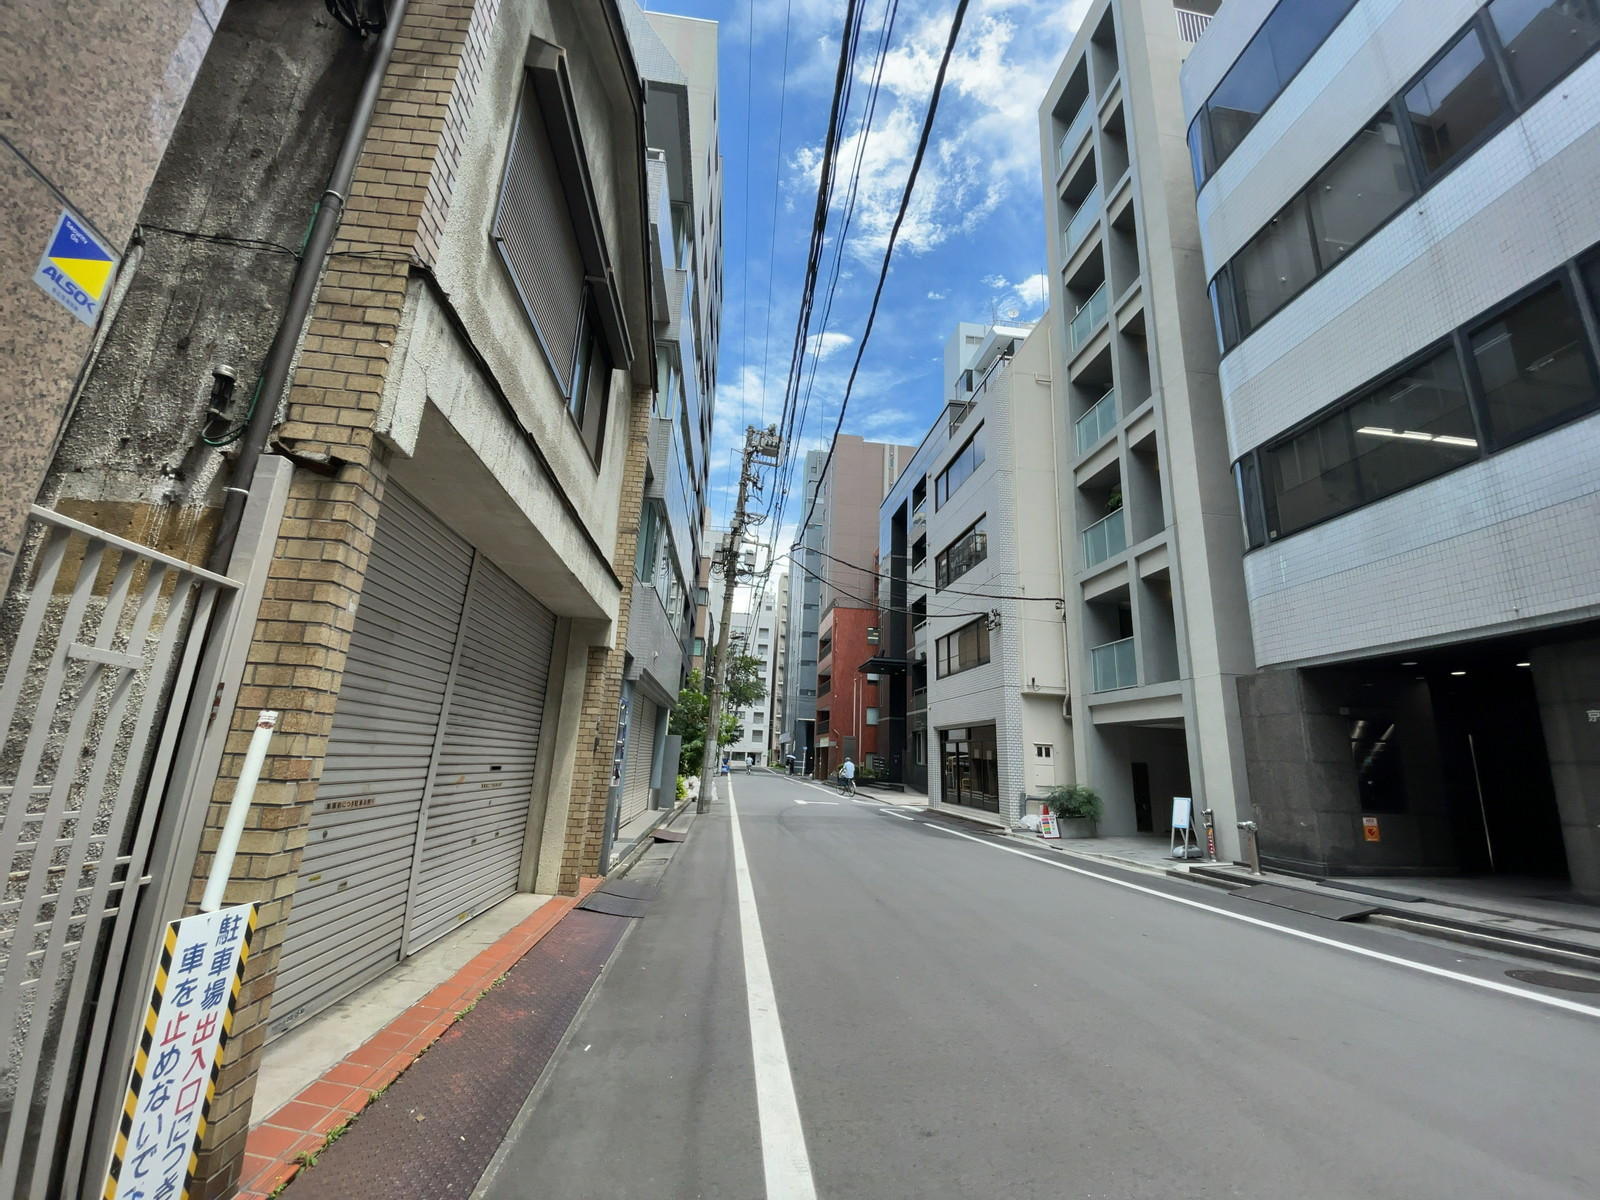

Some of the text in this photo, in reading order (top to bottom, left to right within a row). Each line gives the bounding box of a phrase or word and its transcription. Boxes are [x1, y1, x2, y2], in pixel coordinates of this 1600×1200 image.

[42, 266, 96, 315] ALSOK
[153, 913, 243, 1200] 駐車場出入口につき
